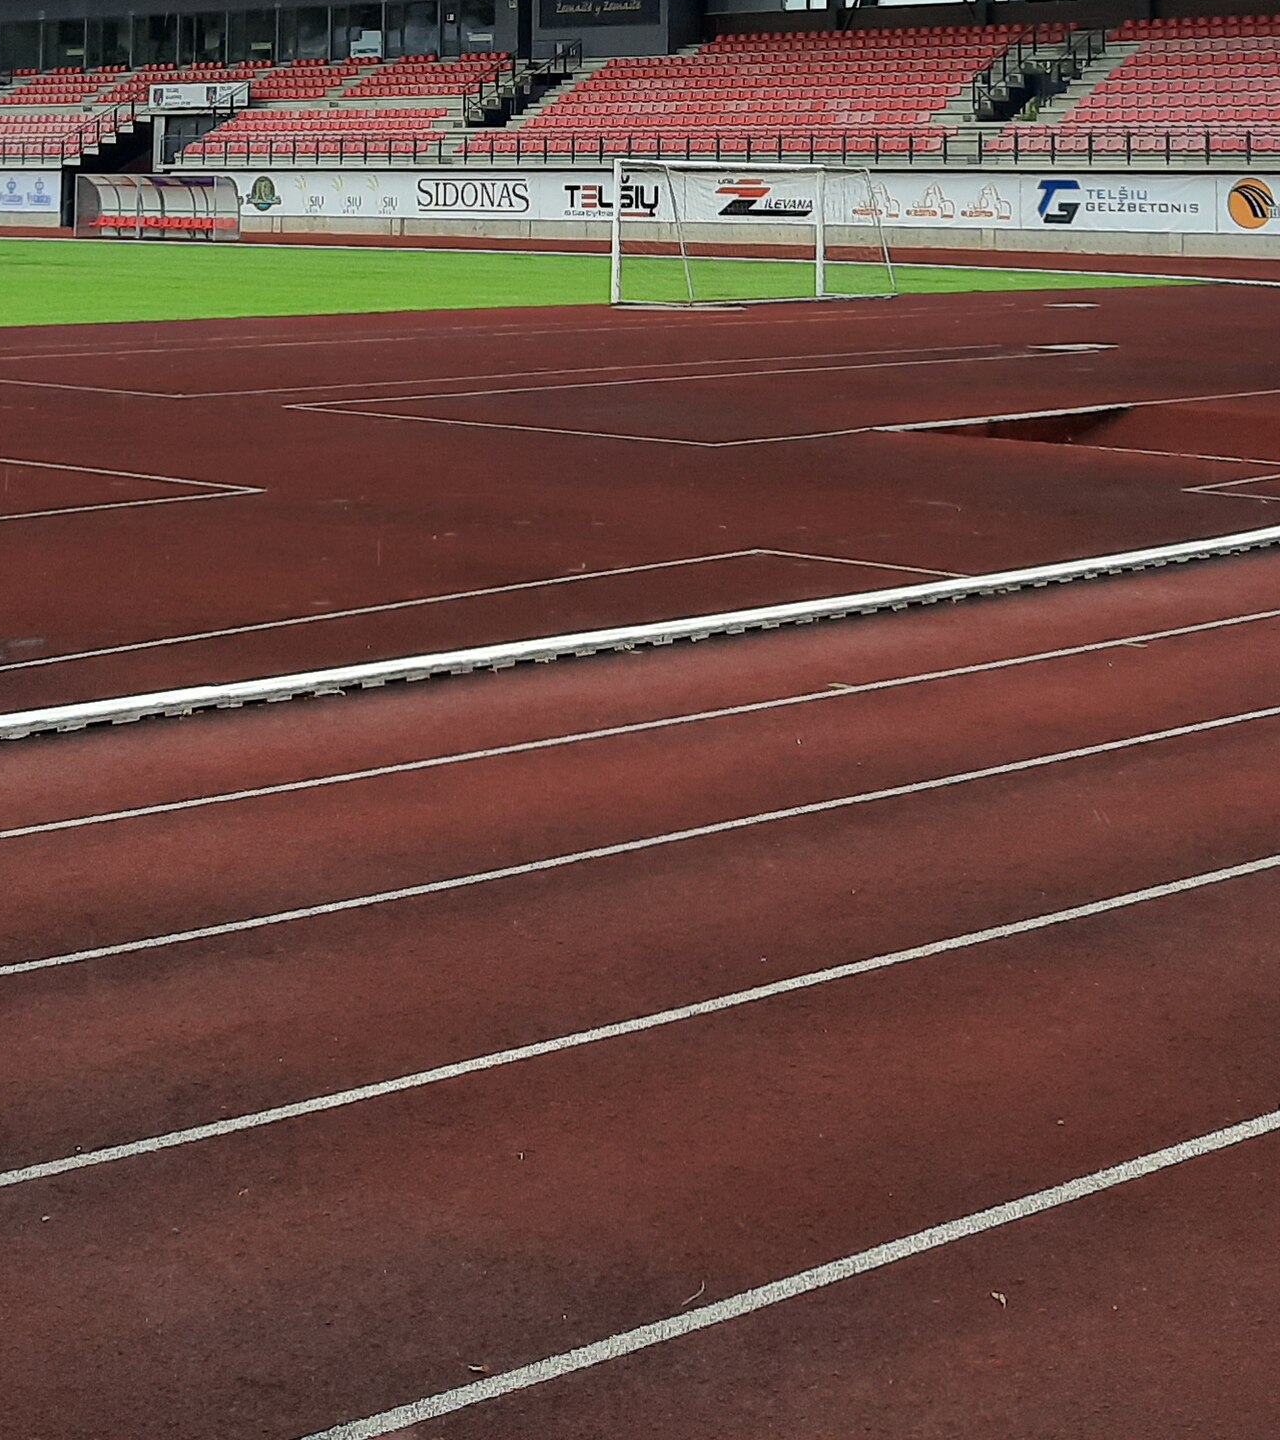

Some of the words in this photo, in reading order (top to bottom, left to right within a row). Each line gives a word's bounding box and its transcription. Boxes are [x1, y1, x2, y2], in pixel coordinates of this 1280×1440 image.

[417, 178, 529, 212] SIDONAS
[564, 175, 659, 217] TELŠIŲ
[1085, 199, 1199, 214] GELŽBETONIS
[1086, 186, 1147, 202] TELŠIŲ
